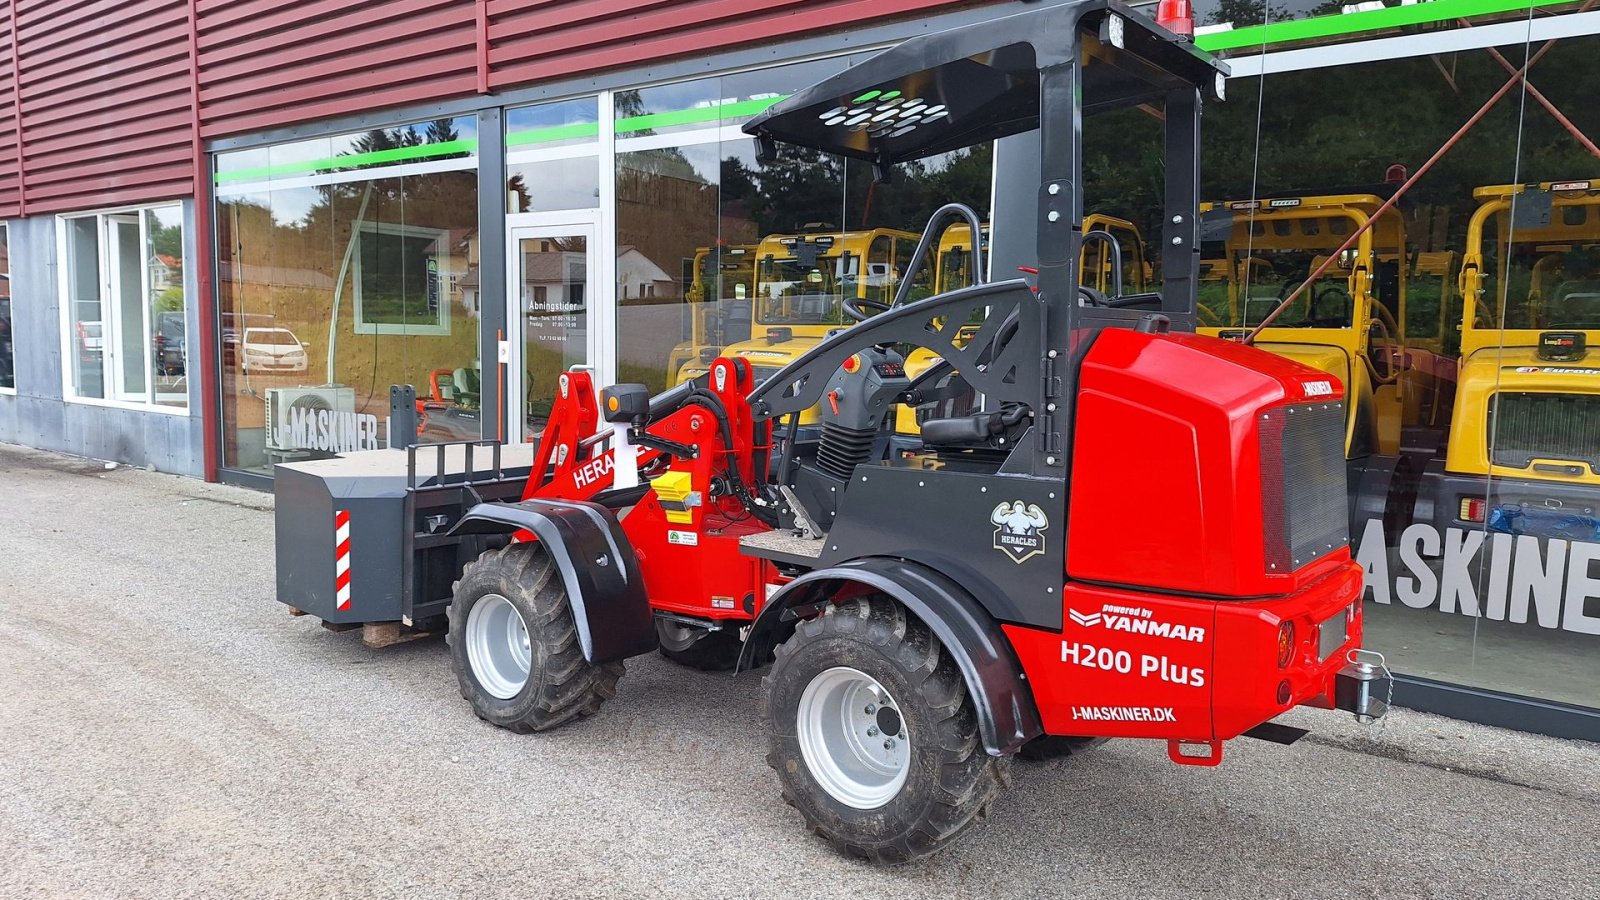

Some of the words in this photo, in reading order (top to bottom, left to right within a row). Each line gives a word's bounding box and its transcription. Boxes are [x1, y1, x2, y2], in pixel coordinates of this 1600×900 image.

[1001, 535, 1037, 547] HERACLES
[1102, 603, 1140, 616] powered
[1141, 608, 1153, 619] by
[1101, 614, 1206, 643] YANMAR
[1060, 640, 1132, 674] H200
[1140, 654, 1205, 687] Plus
[1072, 706, 1177, 722] J-MASKINER.DK
